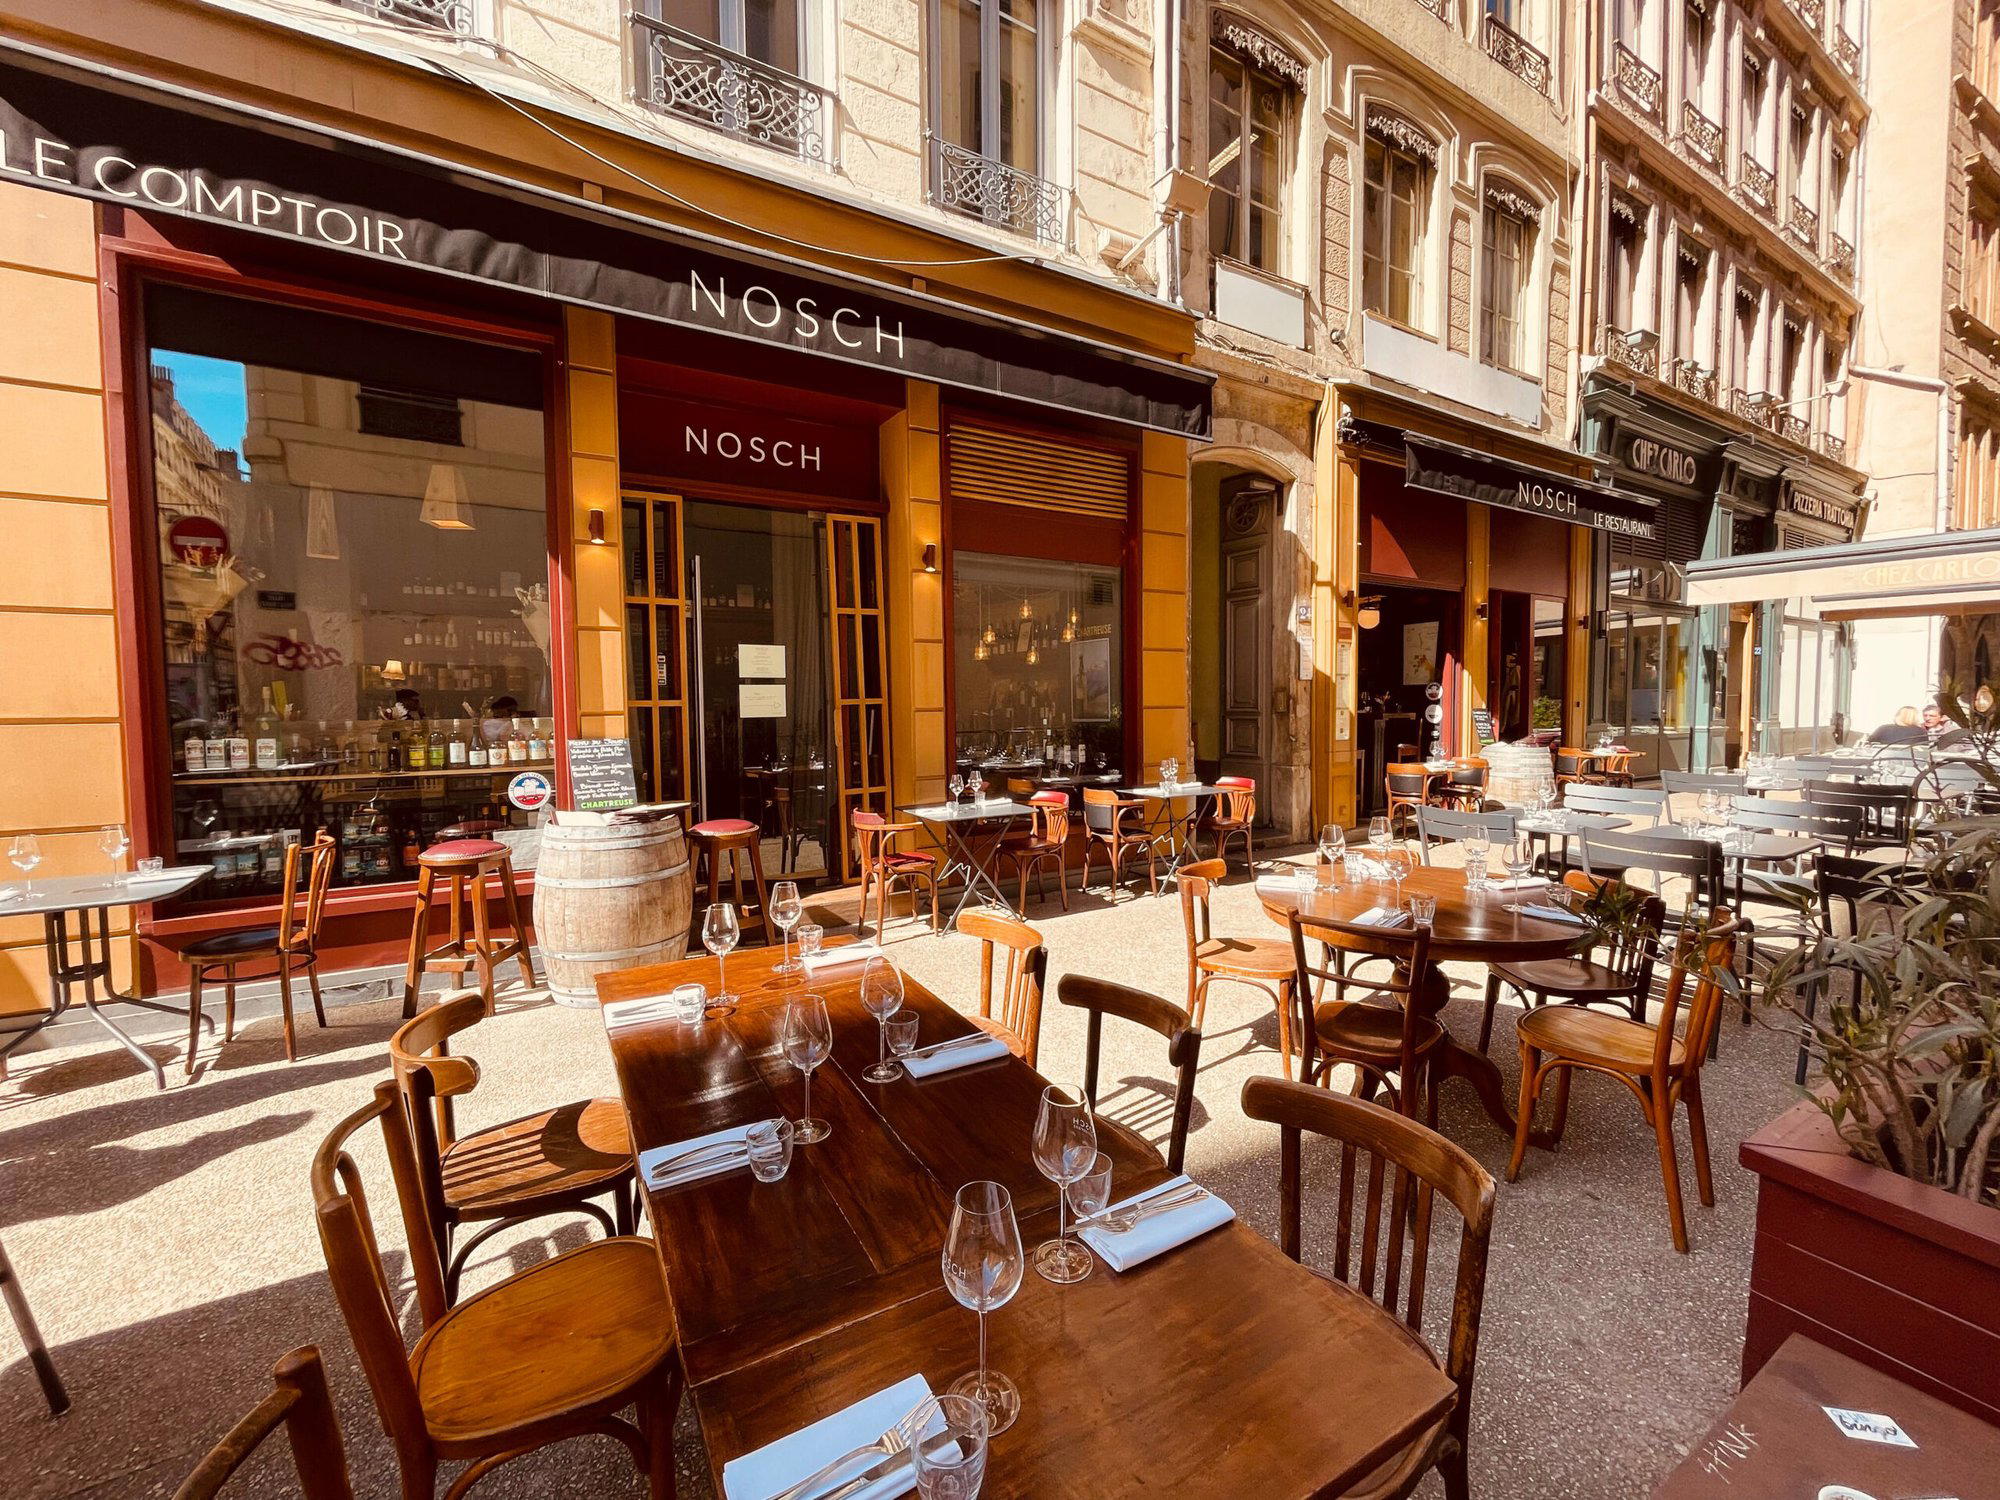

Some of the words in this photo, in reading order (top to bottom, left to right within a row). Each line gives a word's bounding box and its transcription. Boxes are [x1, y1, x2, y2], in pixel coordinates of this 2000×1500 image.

[0, 128, 73, 185] LE
[93, 155, 408, 261] COMPTOIR
[690, 269, 904, 359] NOSCH
[685, 425, 821, 471] NOSCH
[1660, 447, 1697, 485] CARLO
[1518, 481, 1577, 515] NOSCH
[1794, 491, 1823, 519] PIZZERIA
[1594, 512, 1604, 528] LE
[1605, 515, 1652, 537] RESTAURANT
[1862, 565, 1913, 587] CHEZ
[1916, 557, 2000, 582] CARLO
[580, 798, 634, 809] CHARTREUSE
